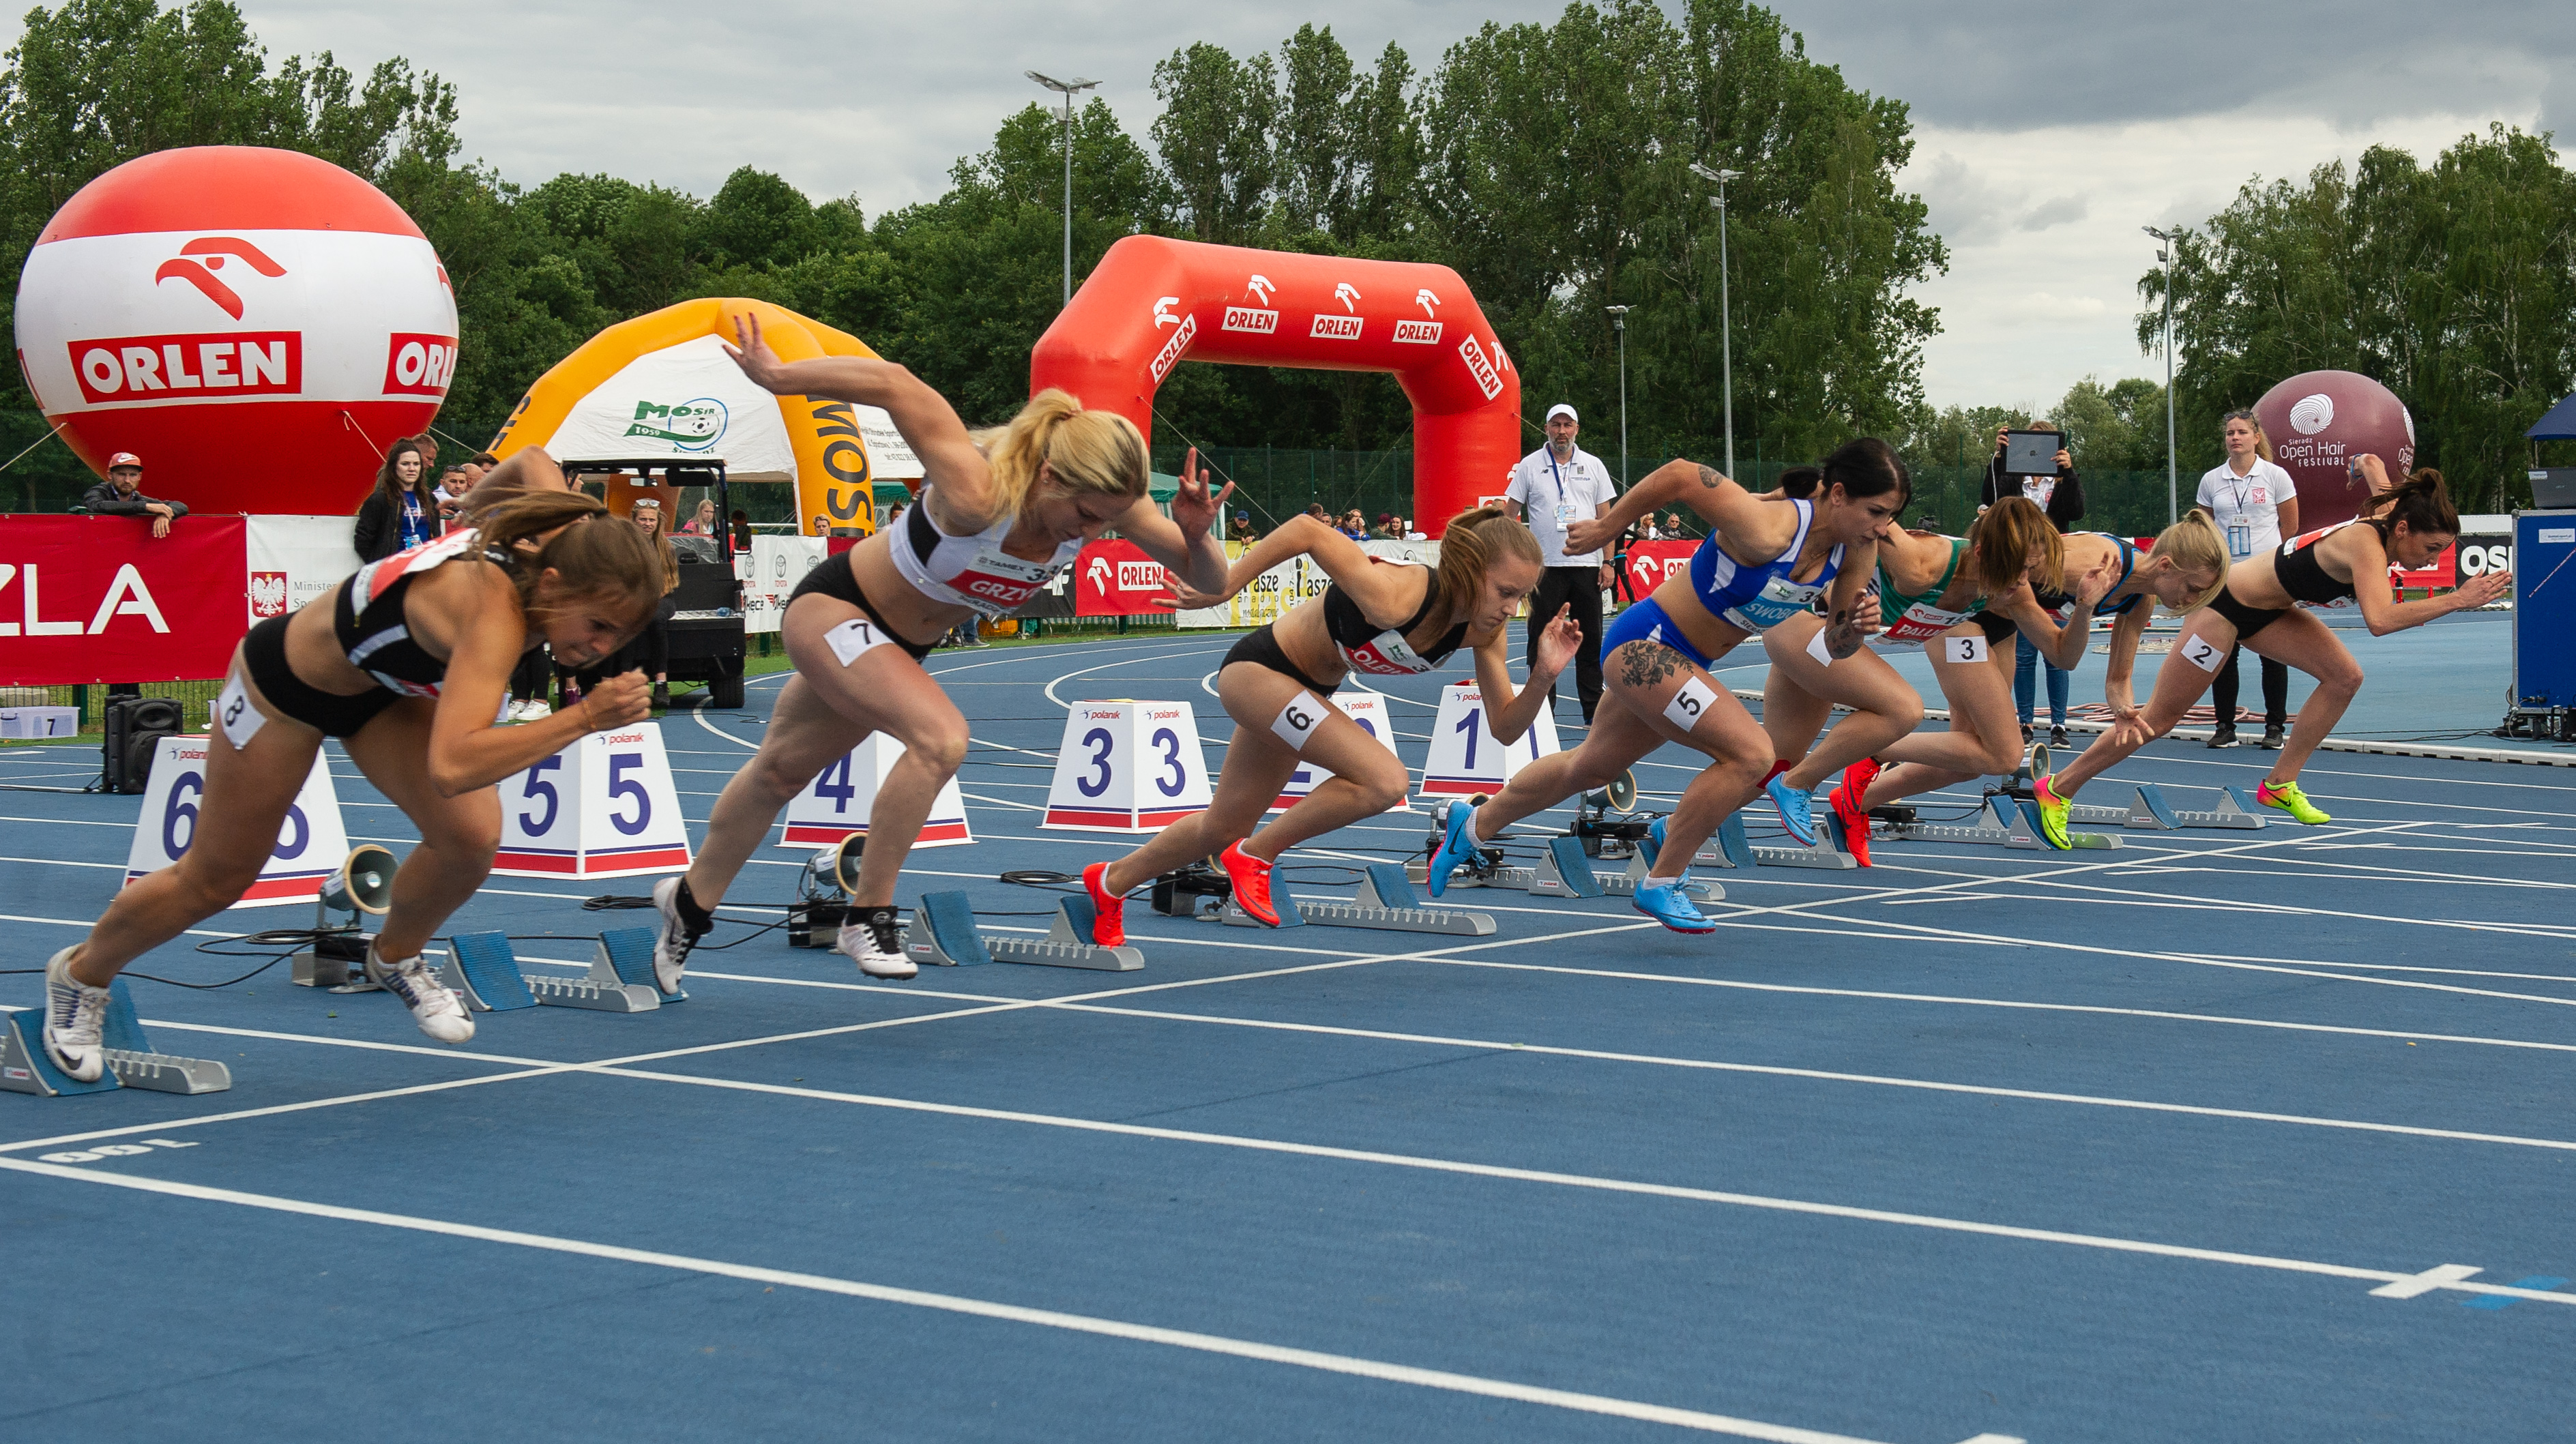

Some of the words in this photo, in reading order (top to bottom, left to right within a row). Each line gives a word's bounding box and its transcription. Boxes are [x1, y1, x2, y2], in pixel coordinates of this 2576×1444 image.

[1227, 311, 1275, 330] ORLEN
[1316, 318, 1360, 336] ORLEN
[1399, 324, 1439, 340] ORLEN
[1154, 322, 1194, 377] ORLEN
[81, 341, 287, 394] ORLEN
[396, 341, 456, 387] ORL
[1464, 341, 1499, 395] ORLEN
[635, 426, 661, 437] 1959
[2288, 437, 2313, 445] Sieradz
[2279, 445, 2313, 461] Open
[2317, 441, 2347, 456] Hair
[2298, 456, 2345, 468] festival
[989, 559, 1026, 572] TAMEX
[1122, 566, 1161, 586] ORLEN
[850, 623, 871, 645] 7
[1961, 638, 1974, 660] 3
[2193, 645, 2212, 665] 2
[226, 695, 244, 728] 8
[1351, 701, 1374, 711] polanik
[1677, 691, 1701, 716] 5
[1091, 710, 1121, 720] polanik
[1154, 709, 1180, 720] polanik
[47, 718, 55, 735] 7
[609, 733, 644, 746] polanik
[1456, 708, 1480, 769] 1
[1077, 727, 1113, 797] 3
[1152, 728, 1186, 797] 3
[815, 750, 855, 813] 4
[518, 754, 562, 838] 5
[609, 753, 652, 836] 5
[163, 771, 205, 861] 6
